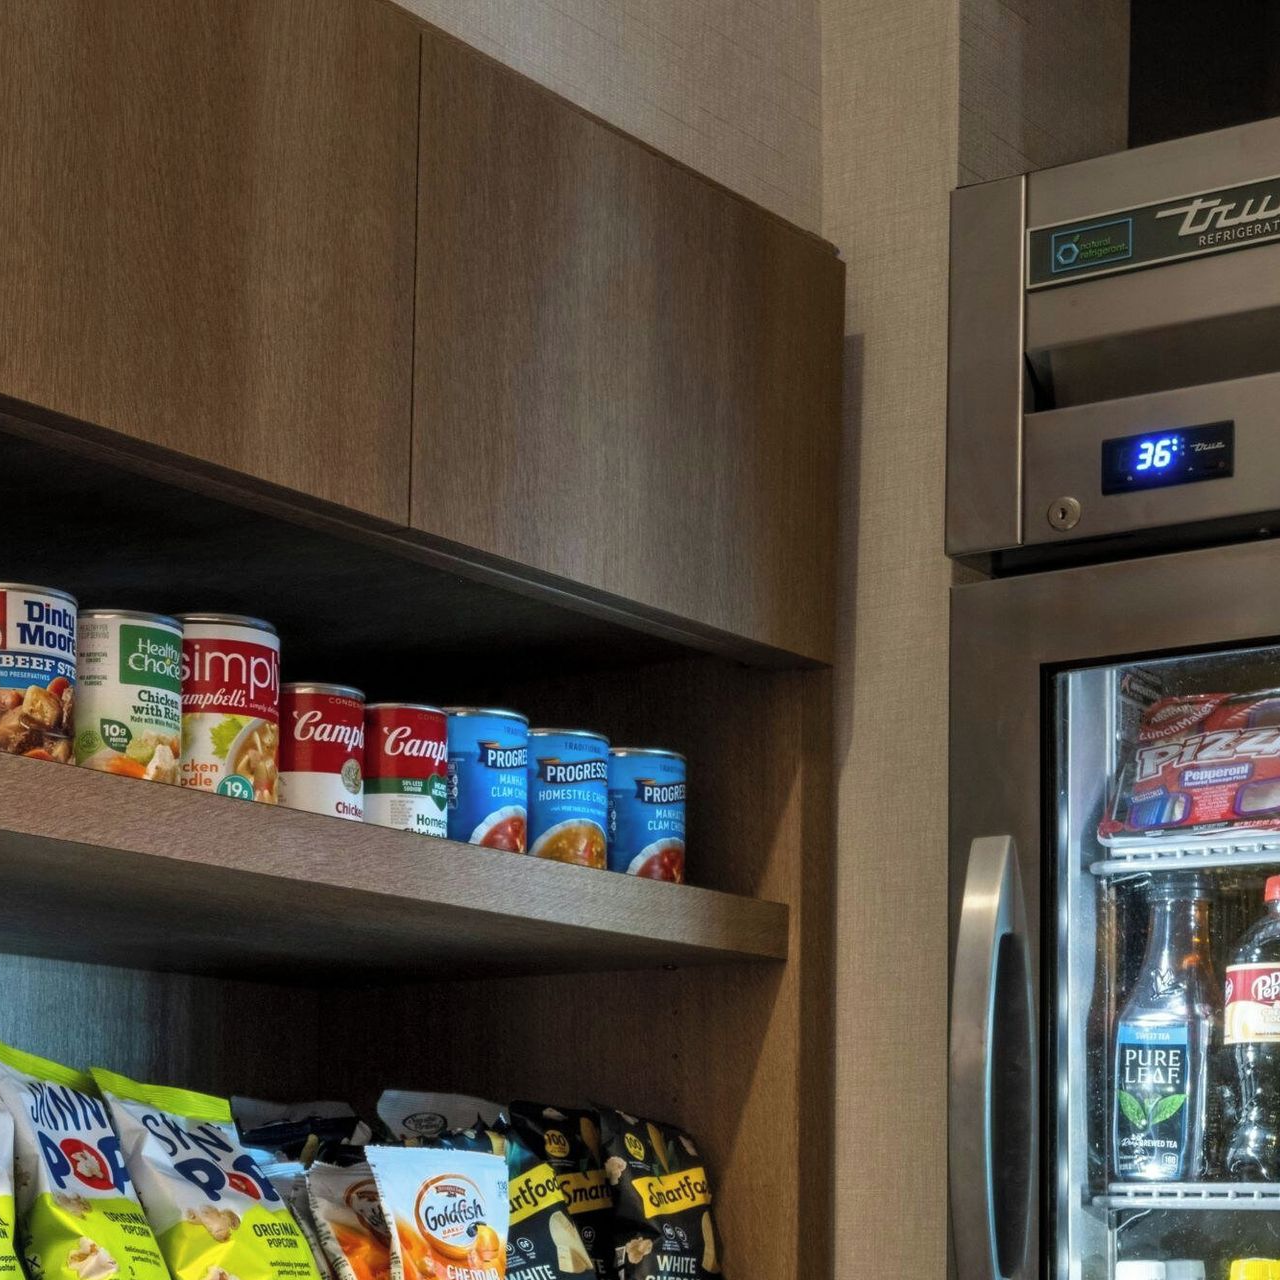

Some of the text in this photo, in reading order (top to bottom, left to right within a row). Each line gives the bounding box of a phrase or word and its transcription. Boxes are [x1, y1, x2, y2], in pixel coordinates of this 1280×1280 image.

[1080, 237, 1111, 252] natural
[24, 600, 76, 636] Dinty
[138, 638, 180, 664] Healthy
[0, 654, 56, 673] BEEF
[128, 653, 181, 680] Choice
[137, 689, 180, 710] Chicken
[132, 704, 162, 720] with
[163, 708, 181, 723] Rice
[1184, 764, 1250, 781] Pepperoni
[1125, 1049, 1181, 1067] PURE
[37, 1131, 131, 1194] POP
[424, 1199, 485, 1232] Goldfish
[252, 1222, 300, 1239] ORIGINAL
[266, 1237, 299, 1250] POPCORN
[656, 1255, 697, 1274] WHITE
